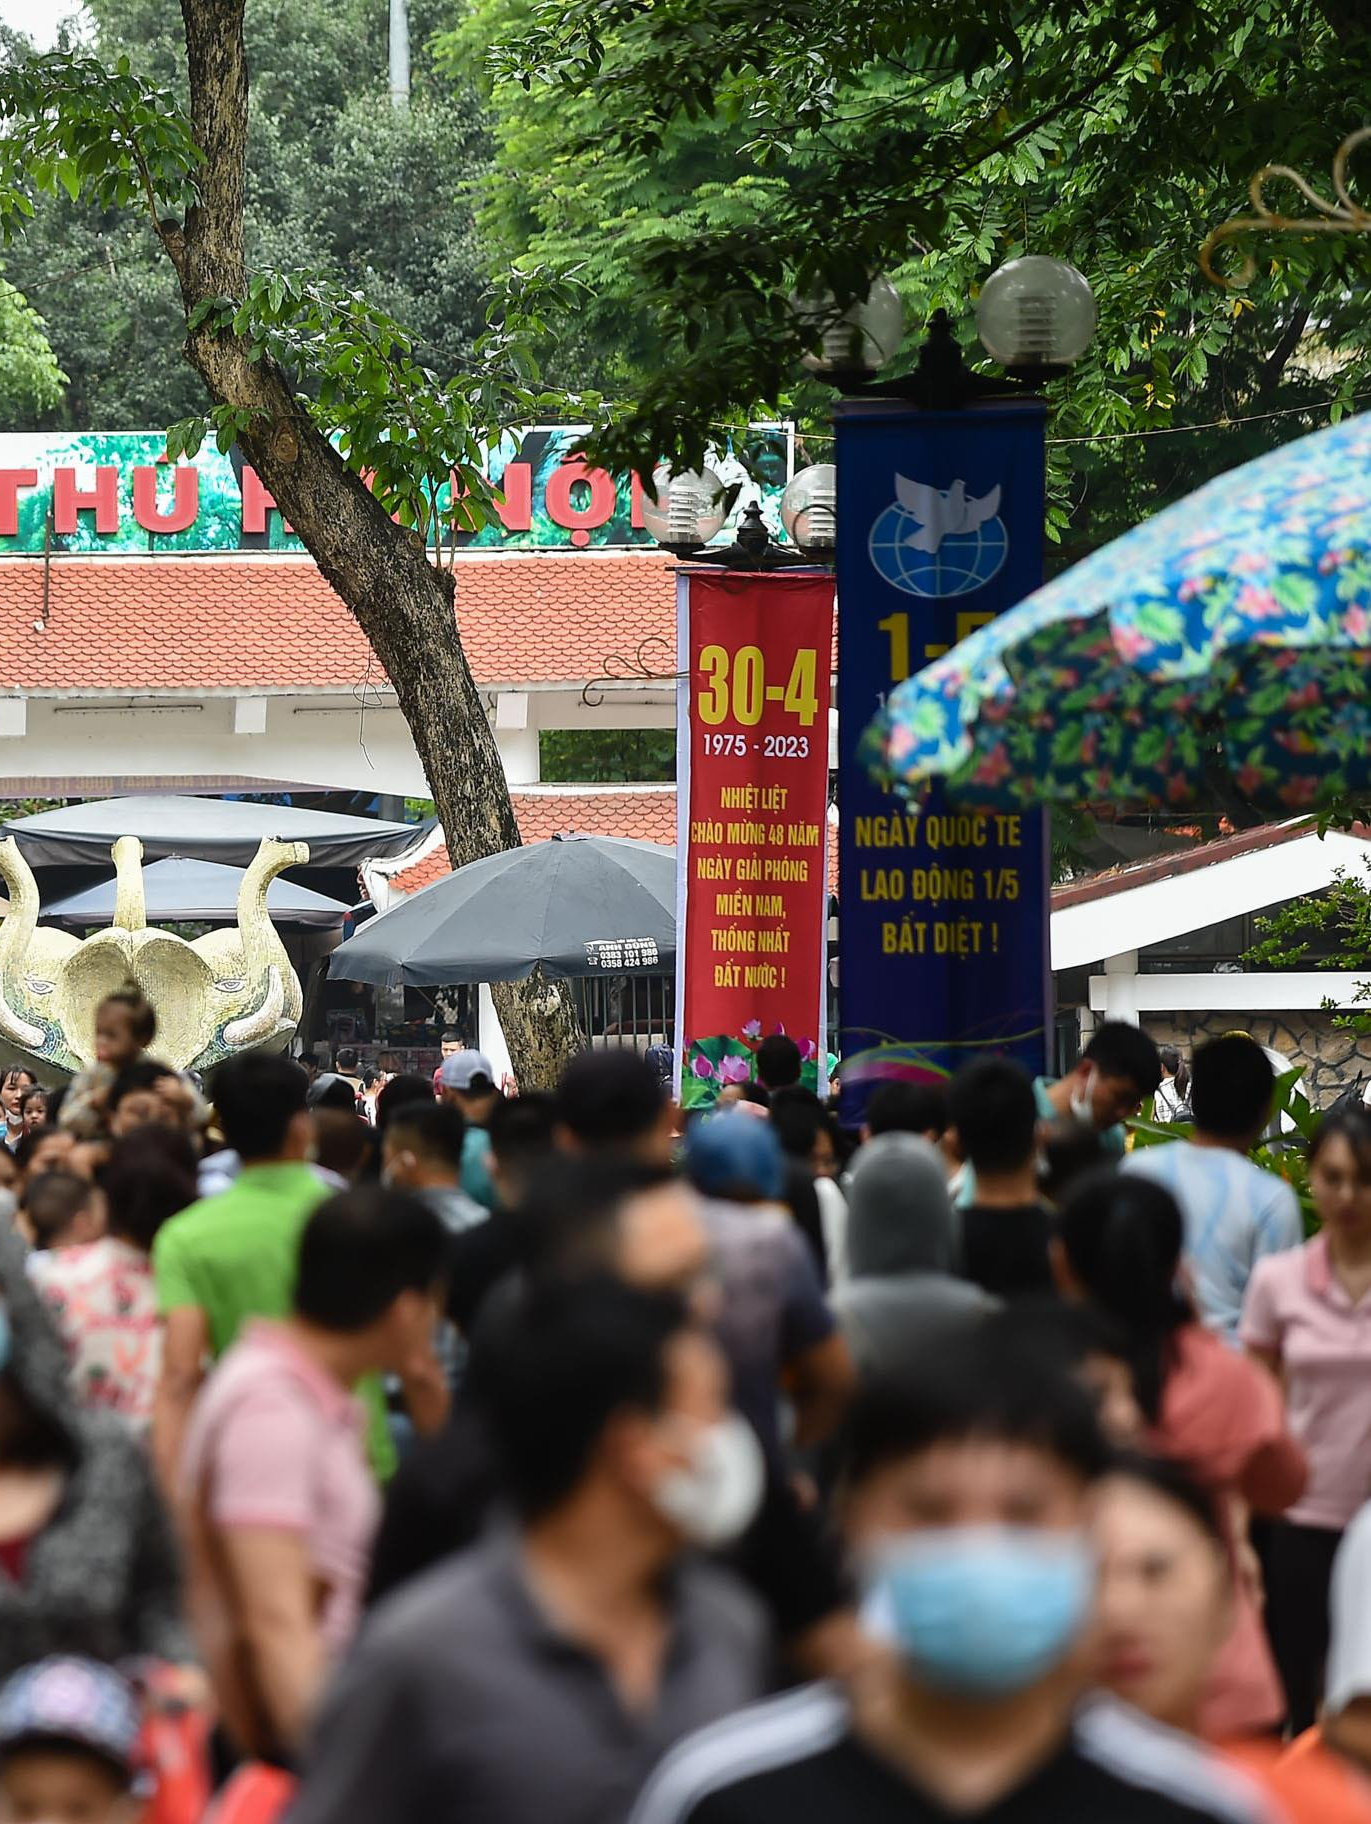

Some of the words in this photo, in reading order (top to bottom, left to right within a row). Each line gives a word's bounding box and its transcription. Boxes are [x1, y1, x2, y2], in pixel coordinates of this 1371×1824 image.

[698, 644, 818, 726] 30-4
[703, 733, 747, 756] 1975
[763, 735, 809, 758] 2023
[720, 783, 759, 814] NHIỆT
[761, 783, 788, 814] LIỆT
[691, 817, 723, 844] CHÀO
[727, 818, 766, 845] MỪNG
[768, 824, 784, 846] 48
[787, 820, 820, 847] NĂM
[854, 809, 919, 847] NGÀY
[697, 853, 732, 880] NGÀY
[736, 851, 762, 881] GIẢI
[764, 855, 808, 882] PHÓNG
[860, 869, 905, 901] LAO
[911, 862, 974, 908] ĐỘNG
[983, 869, 1019, 900] 1/5
[715, 887, 752, 916] MIỀN
[756, 895, 786, 919] NAM,
[710, 922, 755, 952] THỐNG
[758, 923, 790, 953] NHẤT
[881, 911, 927, 954] BẤT
[933, 915, 983, 961] DIỆT
[624, 958, 640, 967] 424
[714, 958, 741, 987] ĐẤT
[744, 962, 777, 988] NƯỚC
